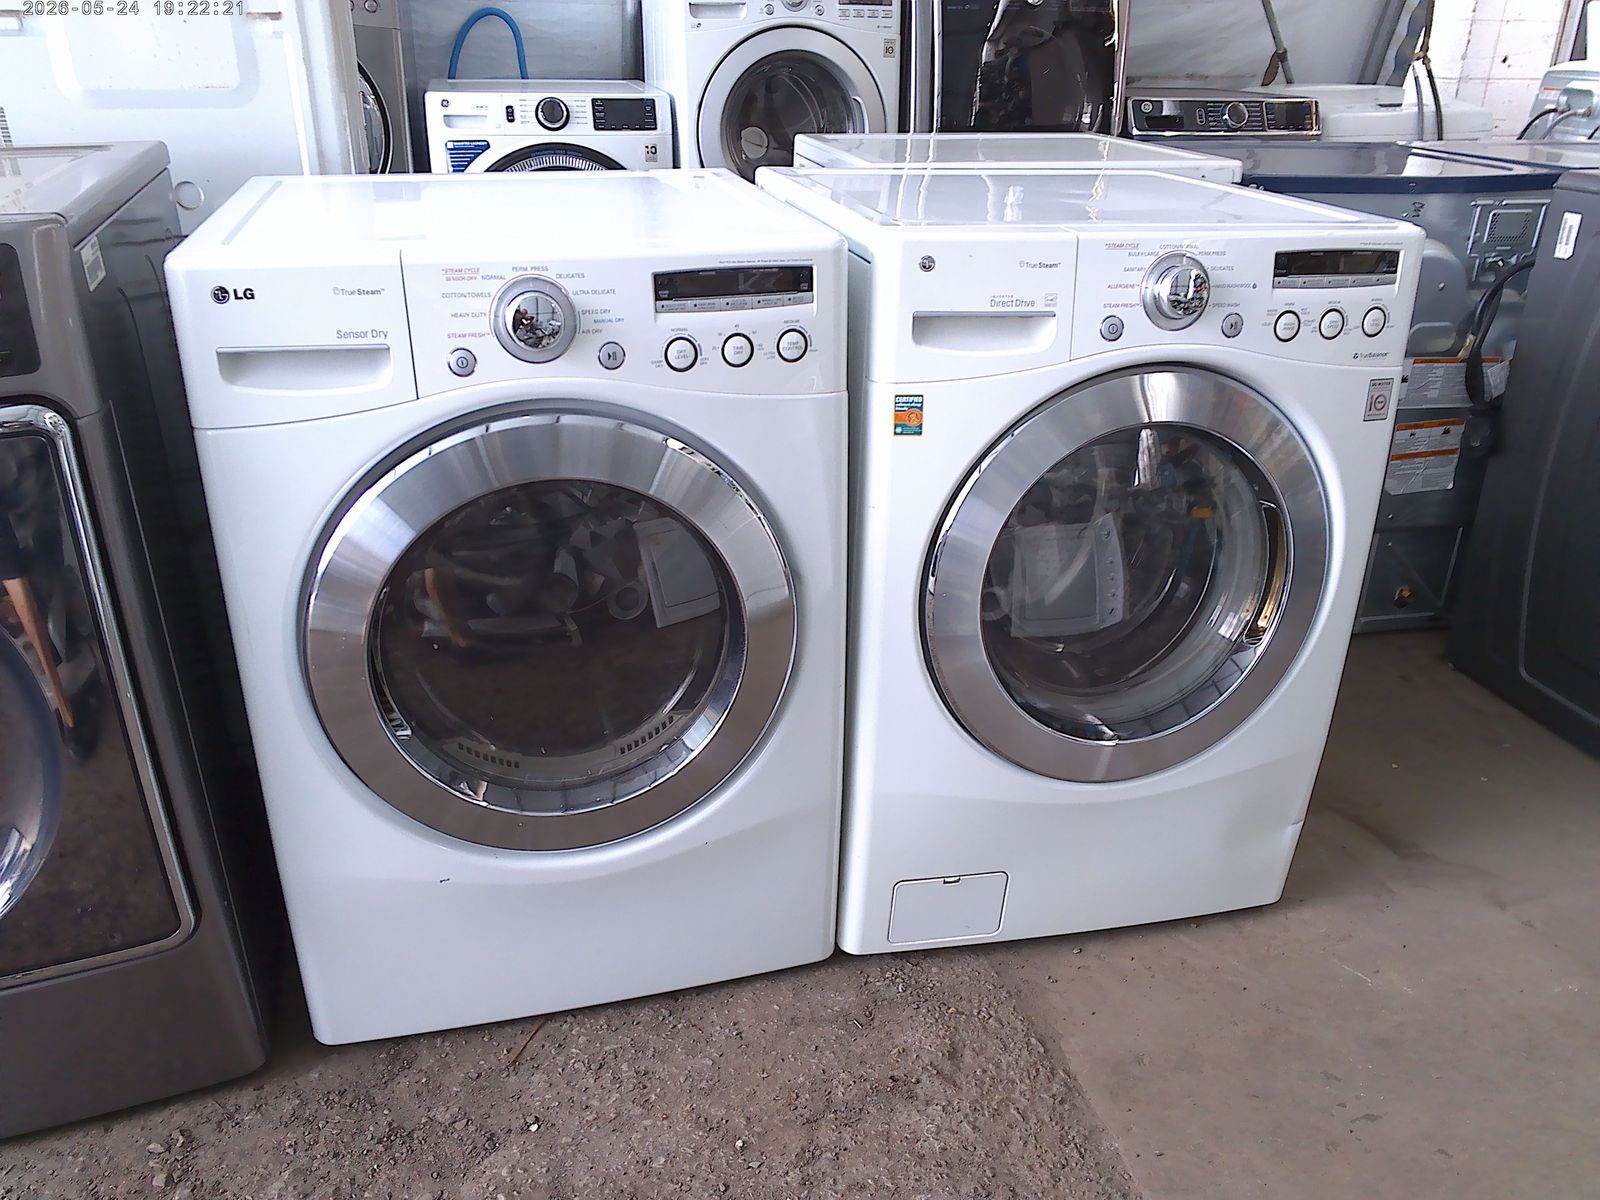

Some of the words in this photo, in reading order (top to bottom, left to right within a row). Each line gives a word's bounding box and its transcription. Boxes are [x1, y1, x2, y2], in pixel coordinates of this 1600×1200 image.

[233, 288, 255, 300] LG
[990, 298, 1014, 308] Direct
[1014, 298, 1036, 307] Drive
[336, 329, 369, 339] Sensor
[371, 329, 388, 341] Dry
